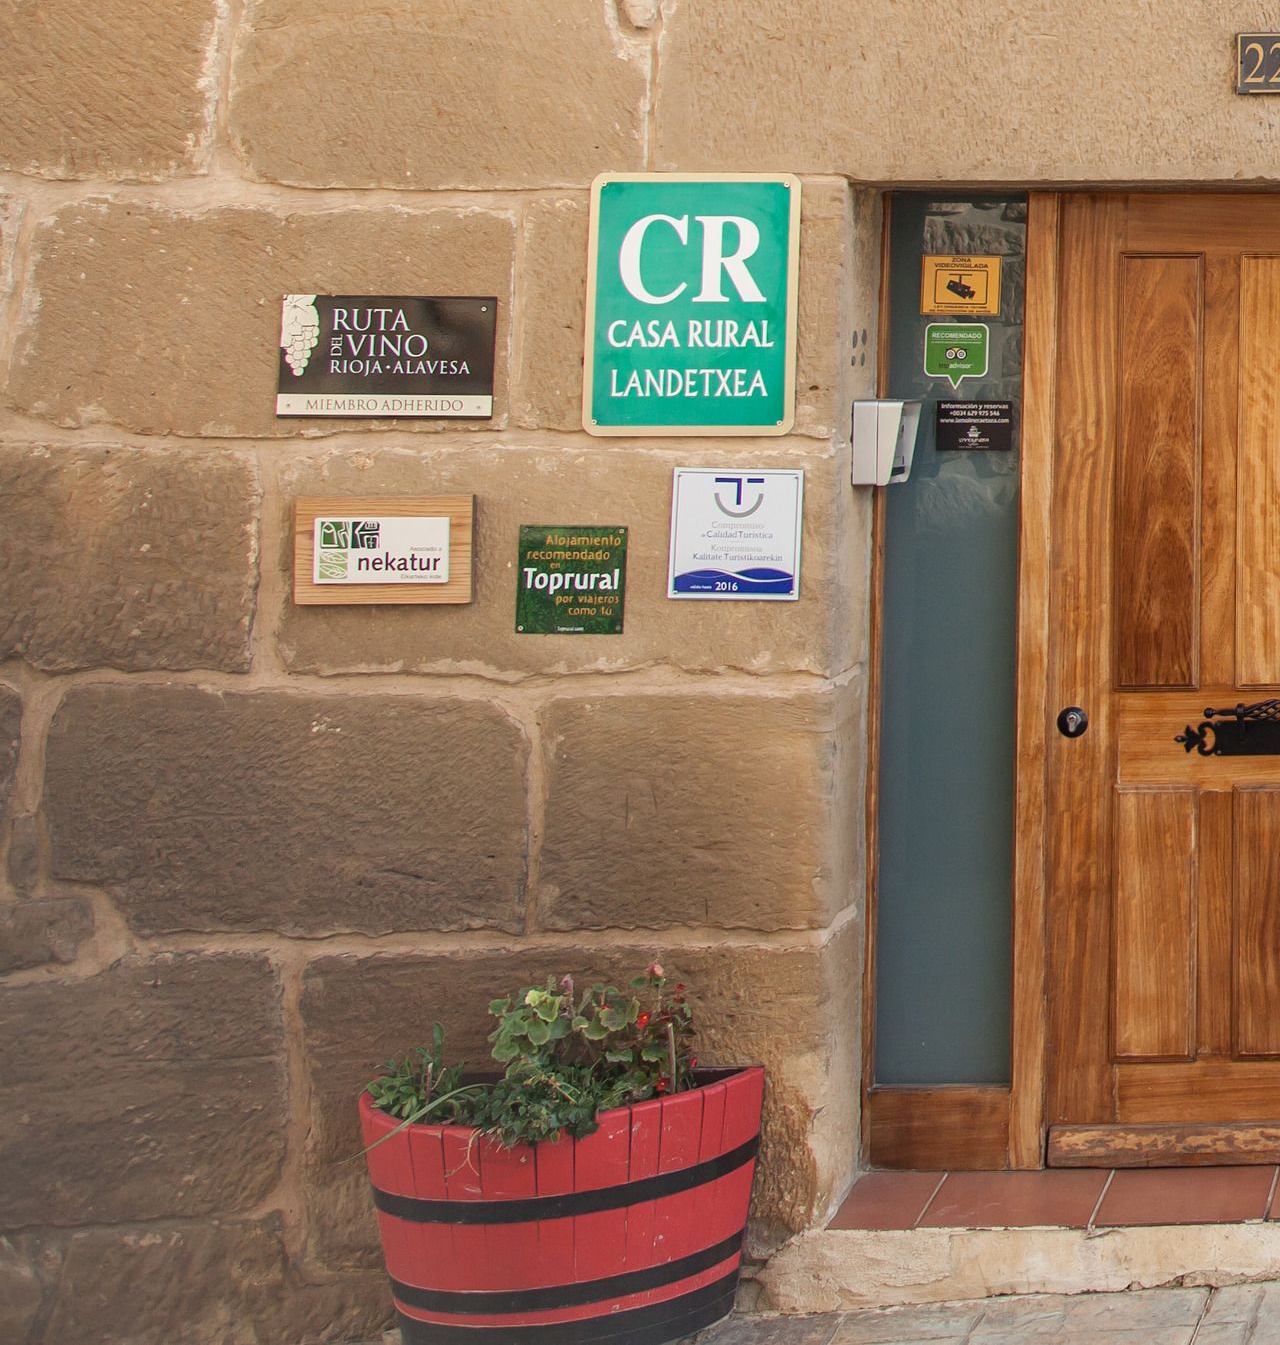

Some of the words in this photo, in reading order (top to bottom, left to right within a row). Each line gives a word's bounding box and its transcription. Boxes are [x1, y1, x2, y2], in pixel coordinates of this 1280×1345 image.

[619, 214, 767, 305] CR
[332, 308, 411, 332] RUTA
[607, 319, 681, 348] CASA
[687, 319, 775, 348] RURAL
[330, 333, 343, 357] DEL
[346, 334, 429, 358] VINO
[330, 359, 383, 377] RIOJA
[392, 360, 471, 375] ALAVESA
[610, 368, 768, 397] LANDETXEA
[306, 398, 378, 412] MIEMBRO
[381, 399, 464, 413] ADHERIDO
[711, 520, 764, 530] Compromiso
[545, 534, 622, 547] Alojamiento
[706, 530, 737, 539] Calidad
[357, 551, 441, 572] nekatur
[525, 549, 611, 561] recomendado
[692, 553, 721, 561] Kalitate
[523, 567, 620, 595] Toprural
[714, 581, 738, 591] 2016
[555, 595, 573, 606] por
[577, 594, 620, 606] viajeros
[568, 607, 597, 616] como
[600, 606, 613, 616] tú
